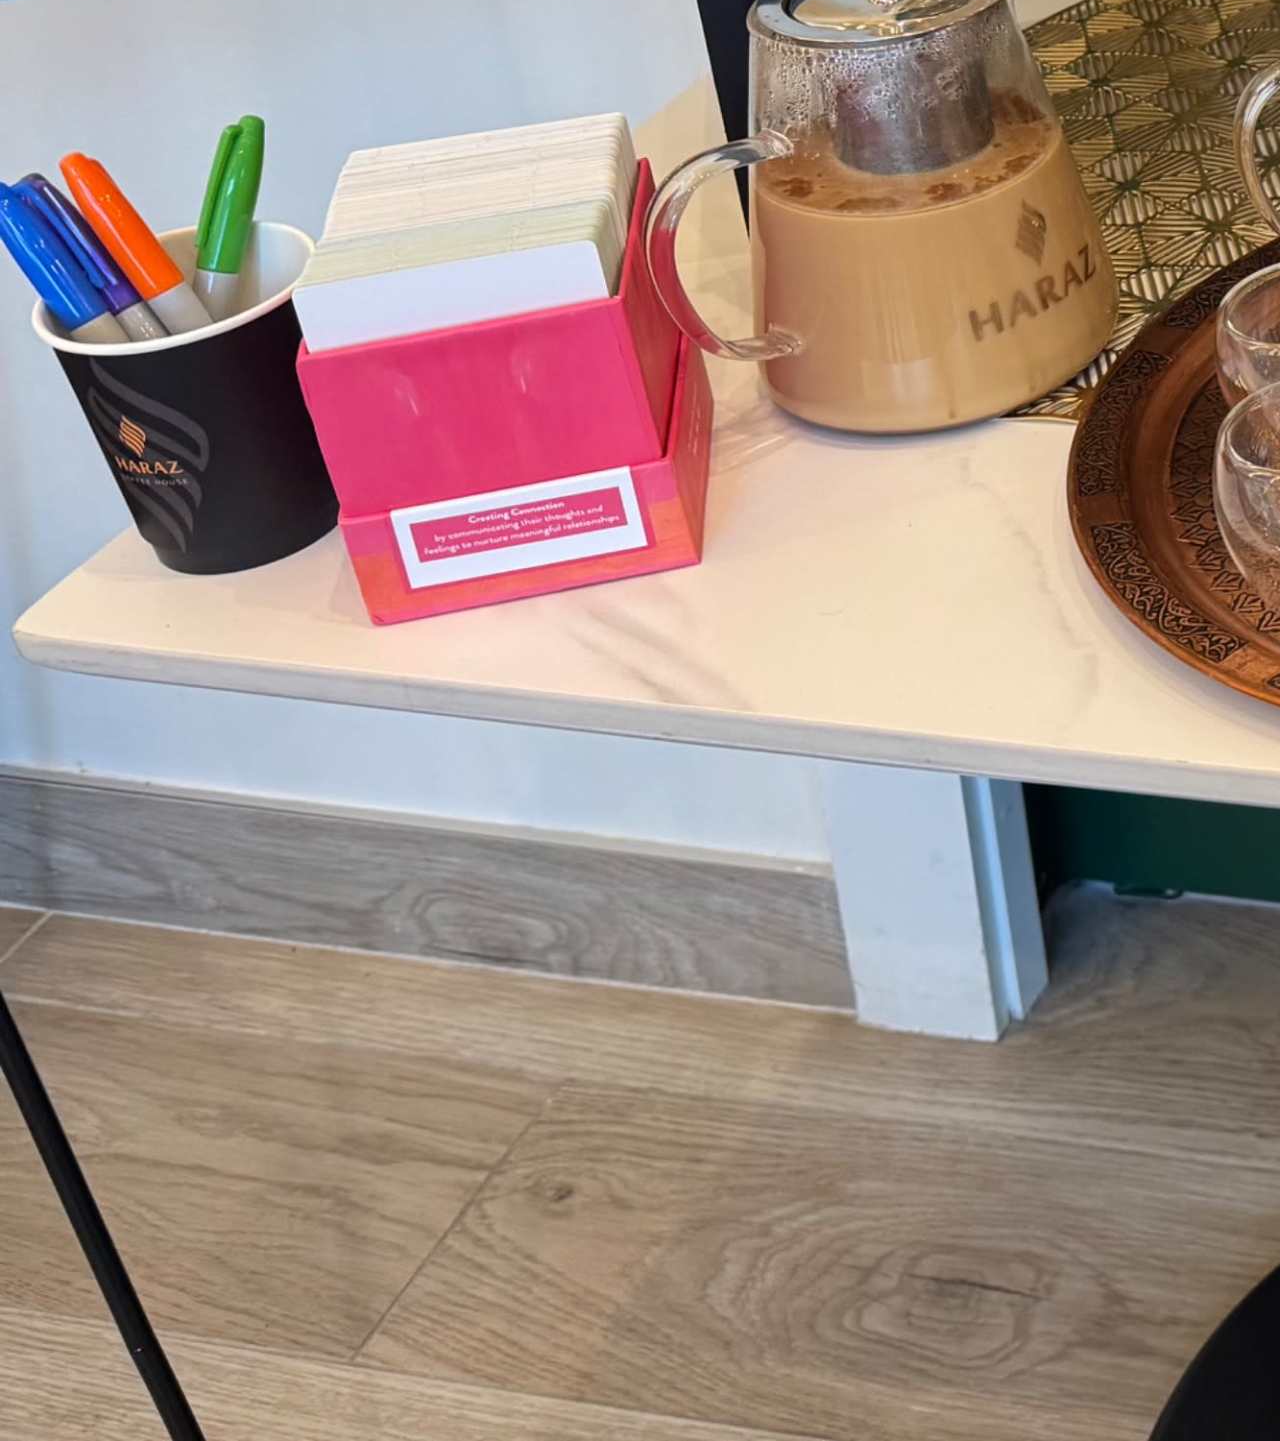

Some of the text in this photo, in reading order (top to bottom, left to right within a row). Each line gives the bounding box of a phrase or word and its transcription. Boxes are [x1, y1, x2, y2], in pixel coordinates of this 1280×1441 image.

[968, 243, 1096, 342] HARAZ
[115, 456, 184, 474] HARAZ
[511, 501, 565, 517] Connection
[434, 534, 446, 543] by
[544, 509, 586, 523] thoughts
[587, 504, 603, 515] and
